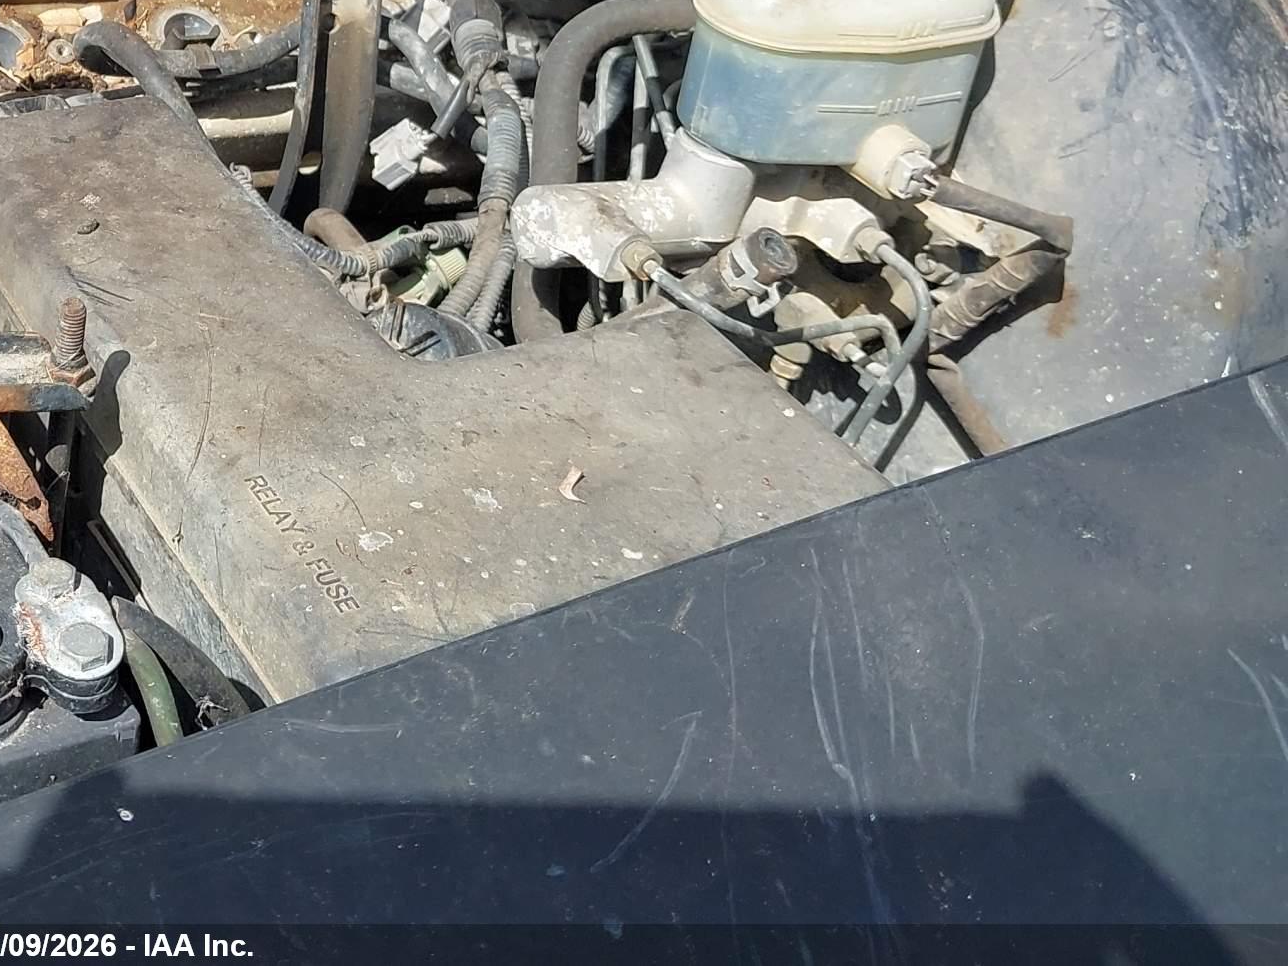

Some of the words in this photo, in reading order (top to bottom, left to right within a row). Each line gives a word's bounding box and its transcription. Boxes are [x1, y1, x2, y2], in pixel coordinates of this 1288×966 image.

[244, 474, 306, 533] RELAY
[292, 539, 315, 556] &
[305, 557, 361, 613] FUSE
